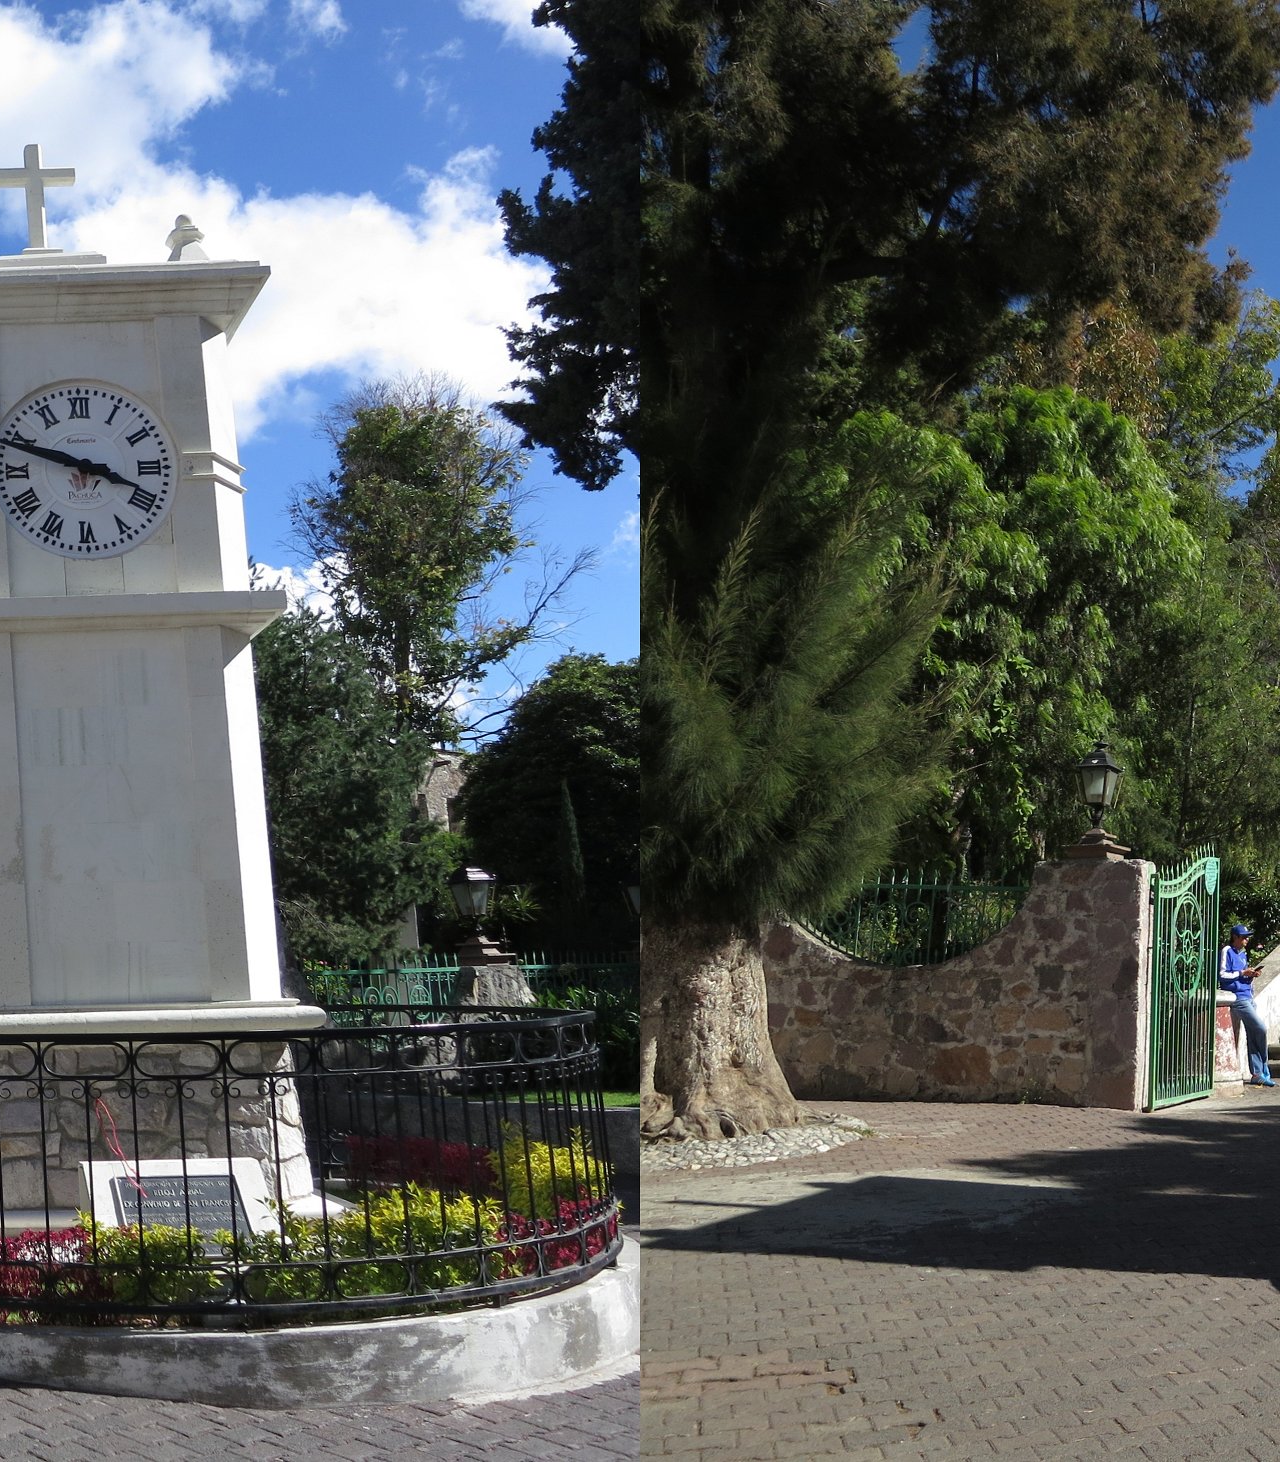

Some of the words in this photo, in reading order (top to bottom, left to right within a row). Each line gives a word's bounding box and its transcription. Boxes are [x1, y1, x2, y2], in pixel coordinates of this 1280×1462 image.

[35, 404, 60, 430] XI
[68, 398, 90, 419] XII
[137, 459, 161, 476] III
[40, 511, 64, 539] VII
[79, 521, 96, 543] VI
